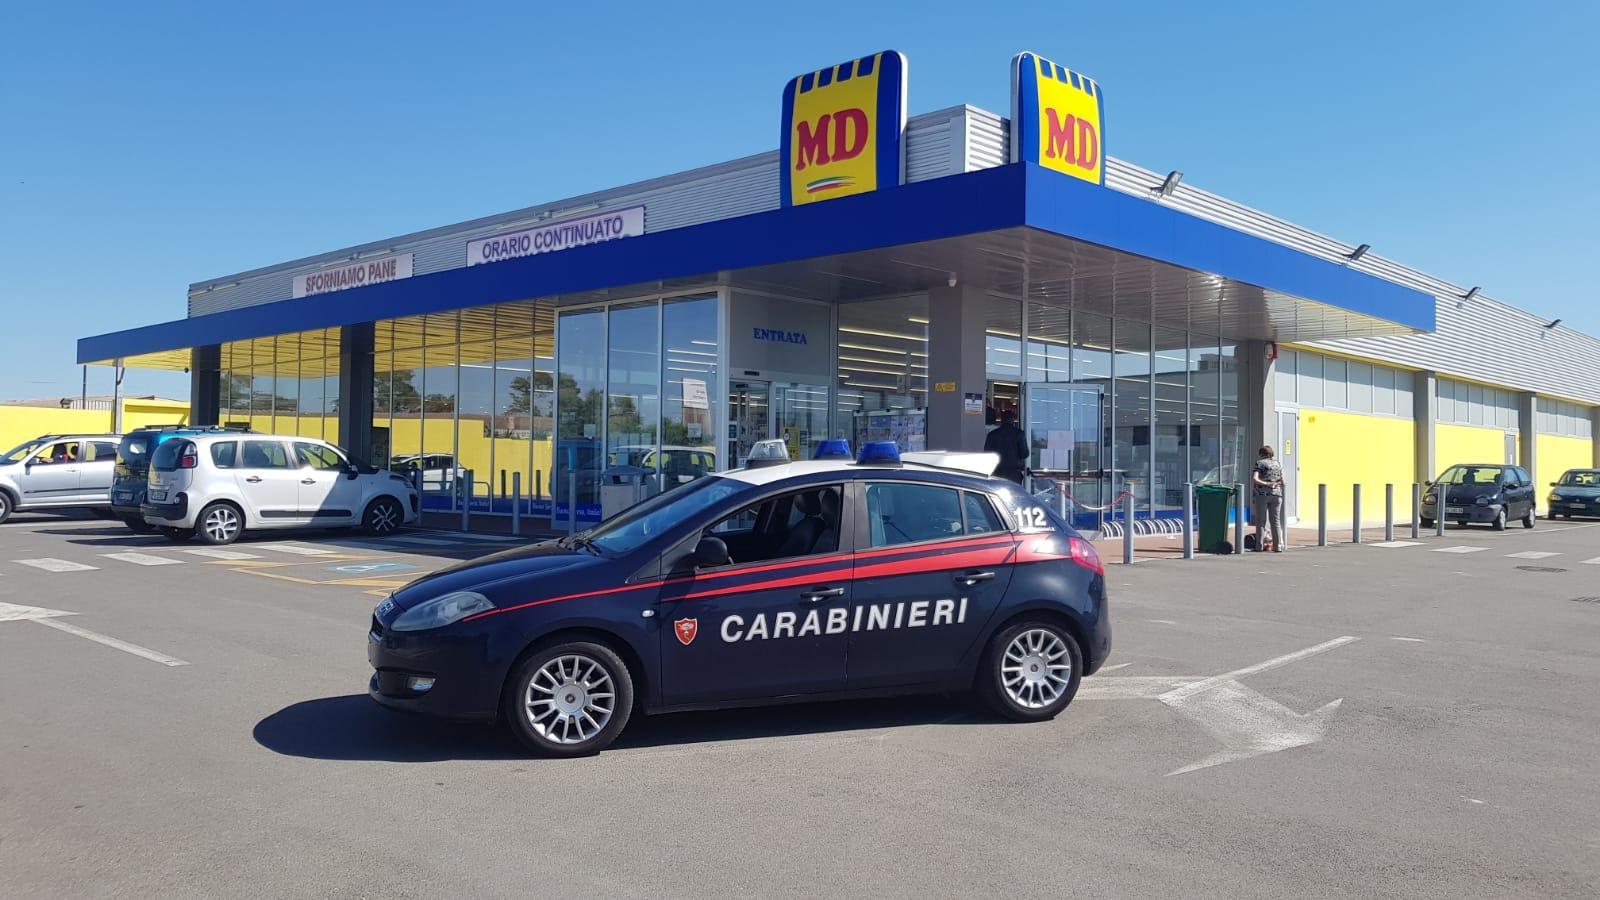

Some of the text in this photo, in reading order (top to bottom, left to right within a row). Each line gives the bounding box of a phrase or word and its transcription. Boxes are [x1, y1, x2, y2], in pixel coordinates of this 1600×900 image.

[795, 107, 869, 172] MD
[1044, 107, 1098, 172] MD
[482, 215, 624, 259] ORARIO CONTINUATO
[305, 258, 397, 292] SFORNIAMO PANE
[753, 328, 808, 345] ENTRATA
[1013, 506, 1047, 527] 112
[720, 597, 968, 642] CARABINIERI
